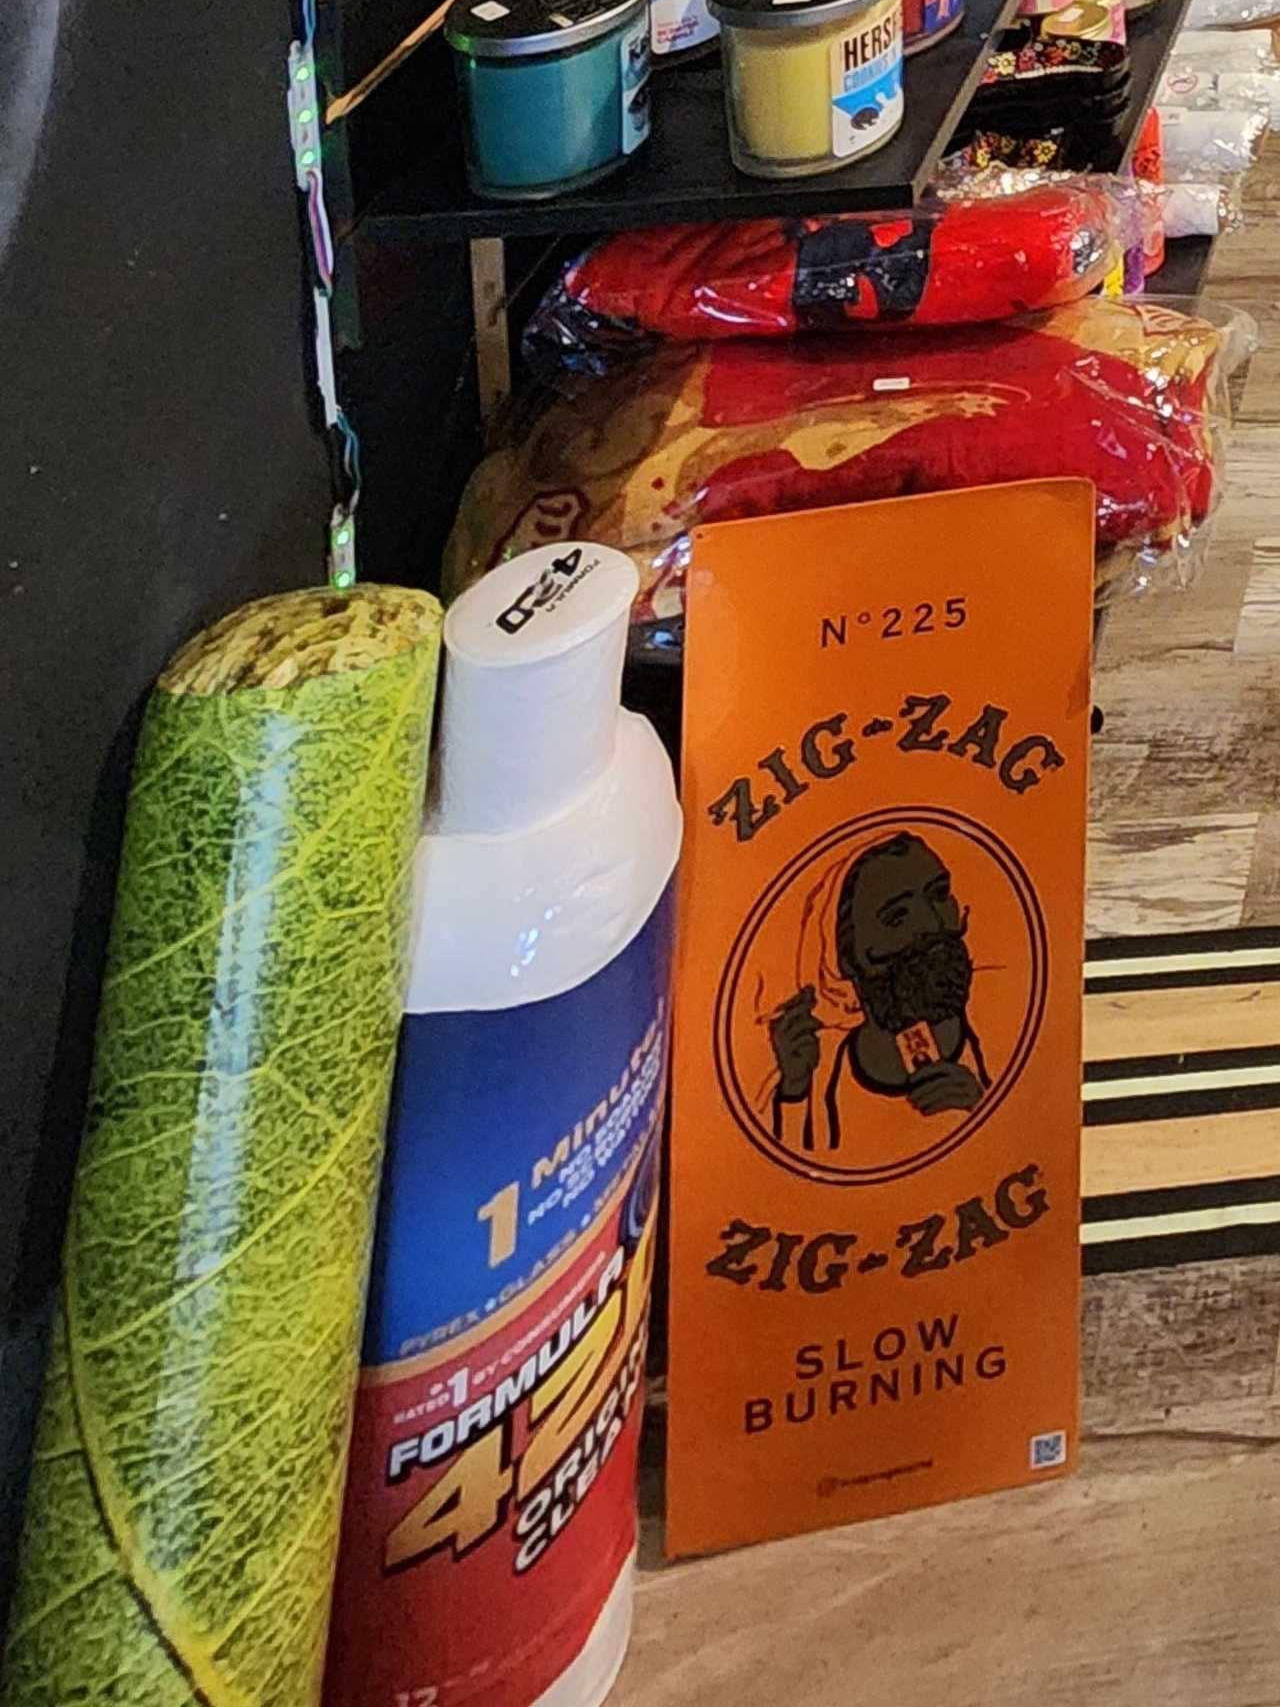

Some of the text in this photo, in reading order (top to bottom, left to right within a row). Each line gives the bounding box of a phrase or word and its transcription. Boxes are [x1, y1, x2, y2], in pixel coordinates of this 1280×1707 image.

[495, 548, 583, 634] 420
[709, 694, 1066, 844] ZIG-ZAG
[477, 1180, 520, 1269] 1
[707, 1163, 1052, 1295] ZIG-ZAG
[387, 1246, 626, 1477] FORMULA
[399, 1309, 480, 1357] PYREX
[795, 1313, 961, 1379] SLOW
[744, 1345, 1008, 1435] BURNING
